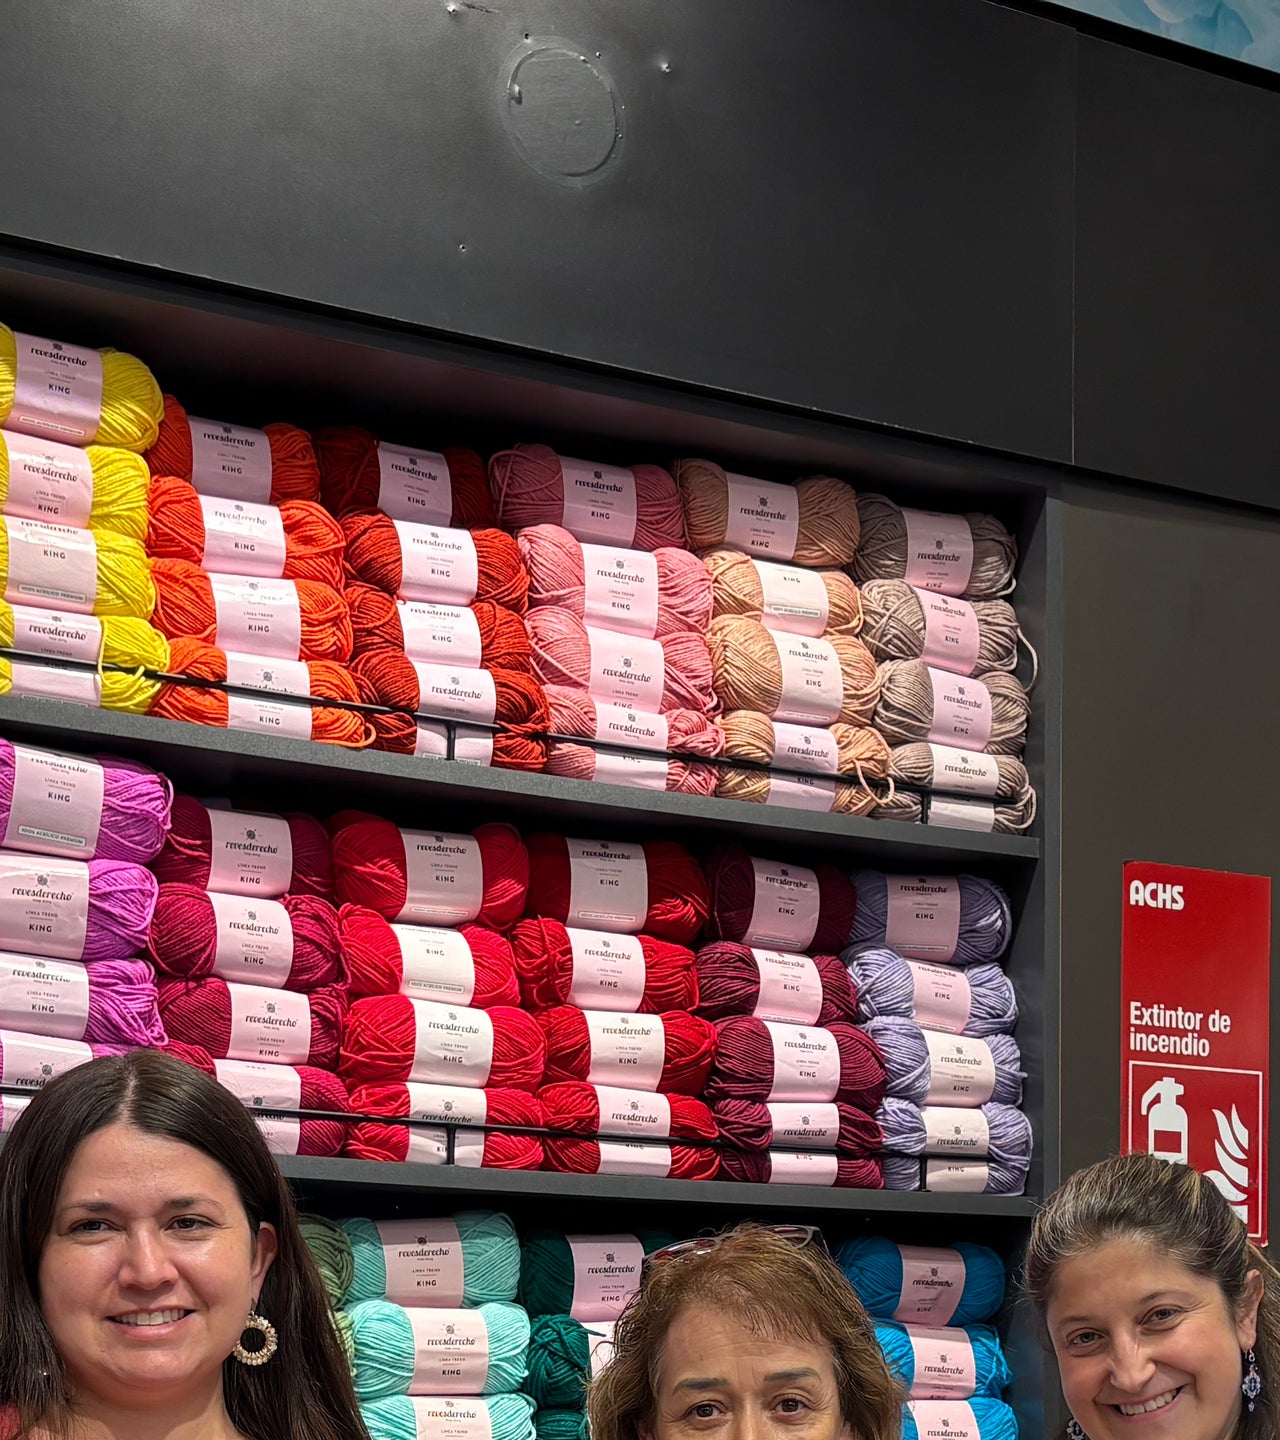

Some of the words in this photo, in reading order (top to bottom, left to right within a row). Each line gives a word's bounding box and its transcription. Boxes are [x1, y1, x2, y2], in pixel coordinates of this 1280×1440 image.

[31, 347, 87, 367] revesderecho
[48, 384, 71, 394] KING
[38, 505, 59, 514] KING
[234, 542, 256, 551] KING
[43, 549, 66, 559] KING
[431, 568, 450, 577] KING
[612, 602, 631, 610] KING
[248, 624, 269, 633] KING
[48, 792, 70, 802] KING
[240, 876, 260, 884] KING
[599, 878, 619, 887] KING
[12, 886, 72, 900] revesderecho
[1129, 880, 1184, 910] ACHS
[29, 923, 52, 933] KING
[1130, 1001, 1203, 1031] Extintor
[1208, 1010, 1231, 1033] de
[1130, 1027, 1209, 1057] incendio
[259, 1048, 279, 1057] KING
[443, 1055, 463, 1063] KING
[799, 1070, 816, 1078] KING
[399, 1247, 449, 1258] revesderecho
[417, 1279, 436, 1287] KING
